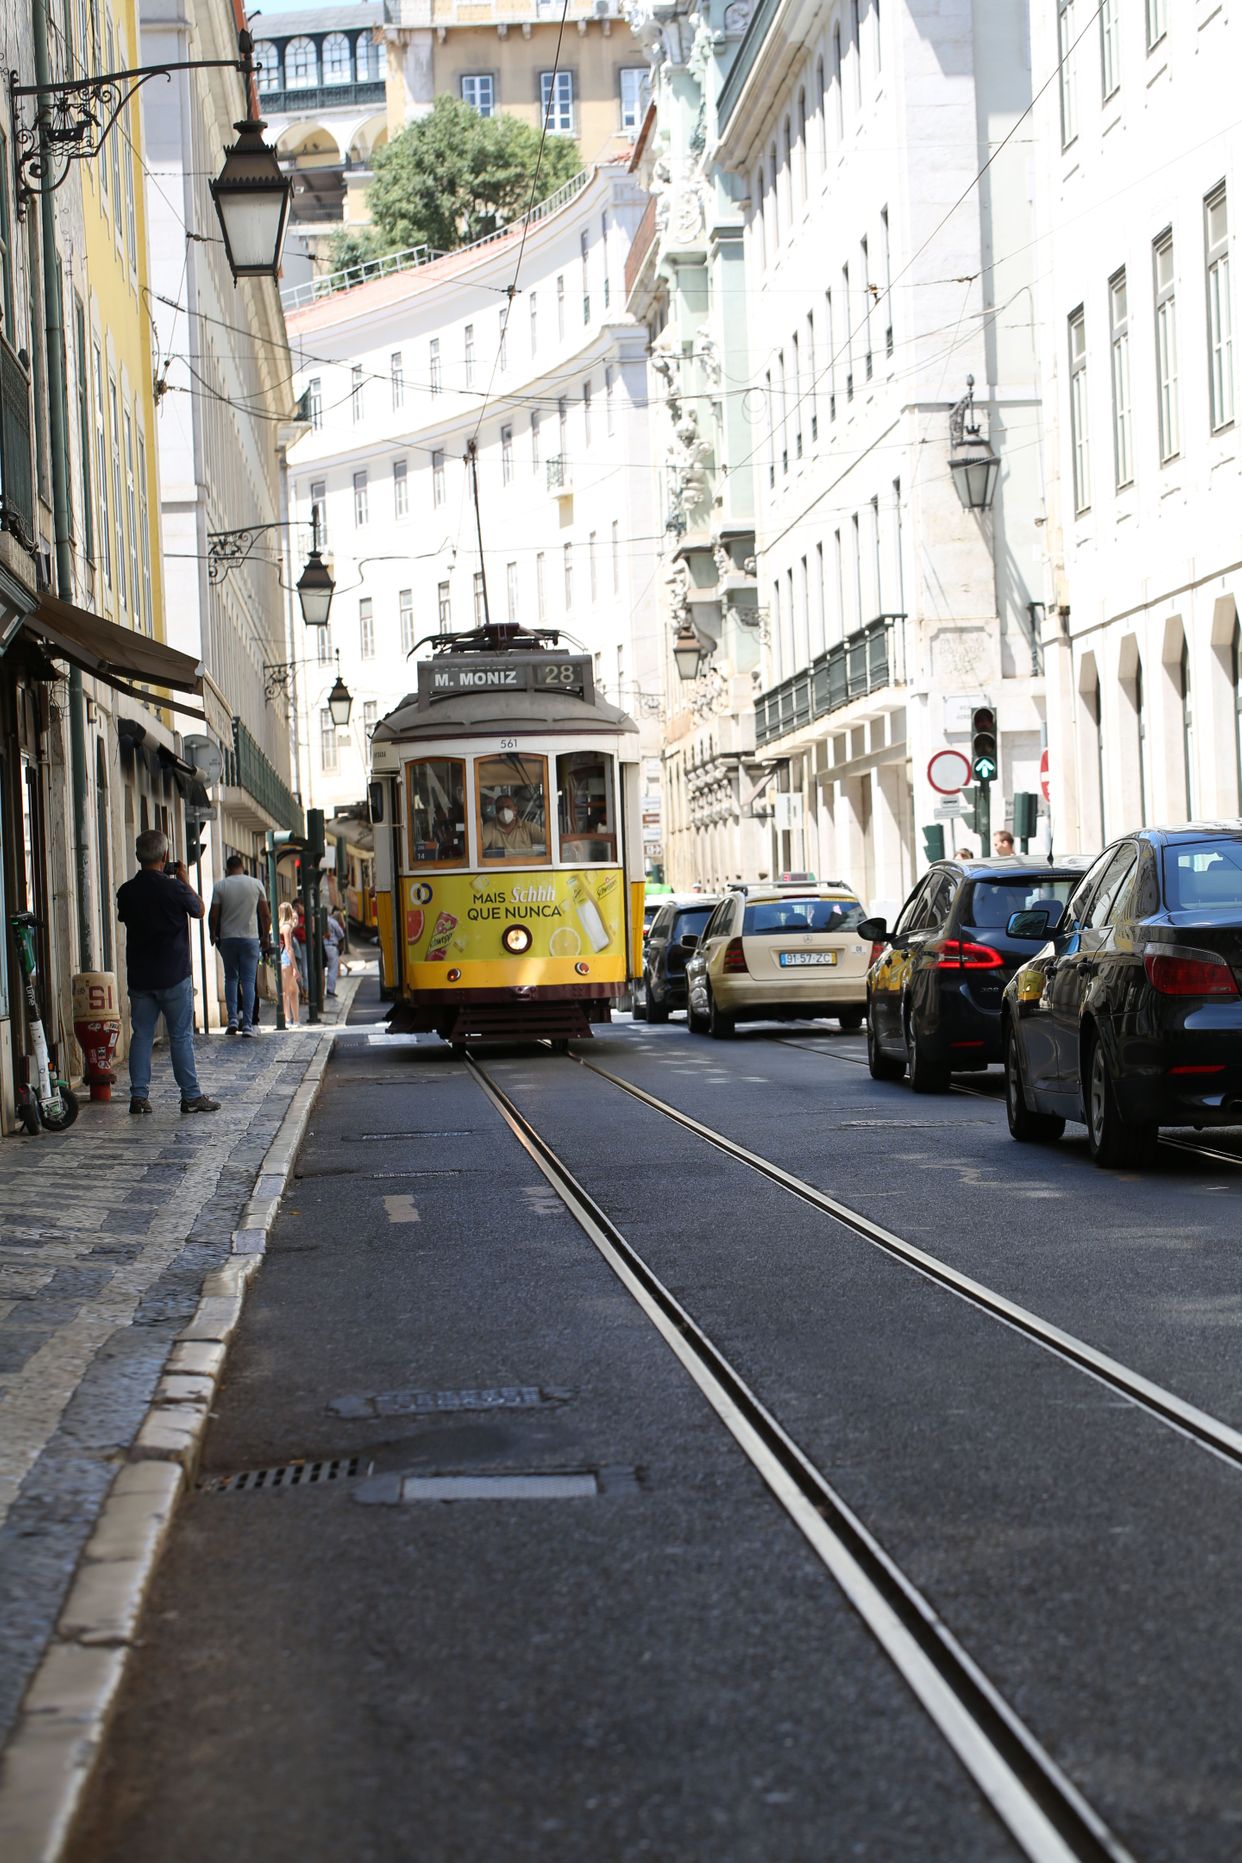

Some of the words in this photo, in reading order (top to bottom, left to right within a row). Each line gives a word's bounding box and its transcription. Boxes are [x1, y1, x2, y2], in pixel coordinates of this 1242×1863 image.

[435, 673, 454, 687] M.
[460, 671, 517, 686] MONIZ
[545, 664, 575, 684] 28
[500, 739, 518, 749] 561
[473, 892, 506, 904] MAIS
[511, 885, 556, 903] Schhh
[467, 907, 501, 921] QUE
[505, 905, 562, 919] NUNCA
